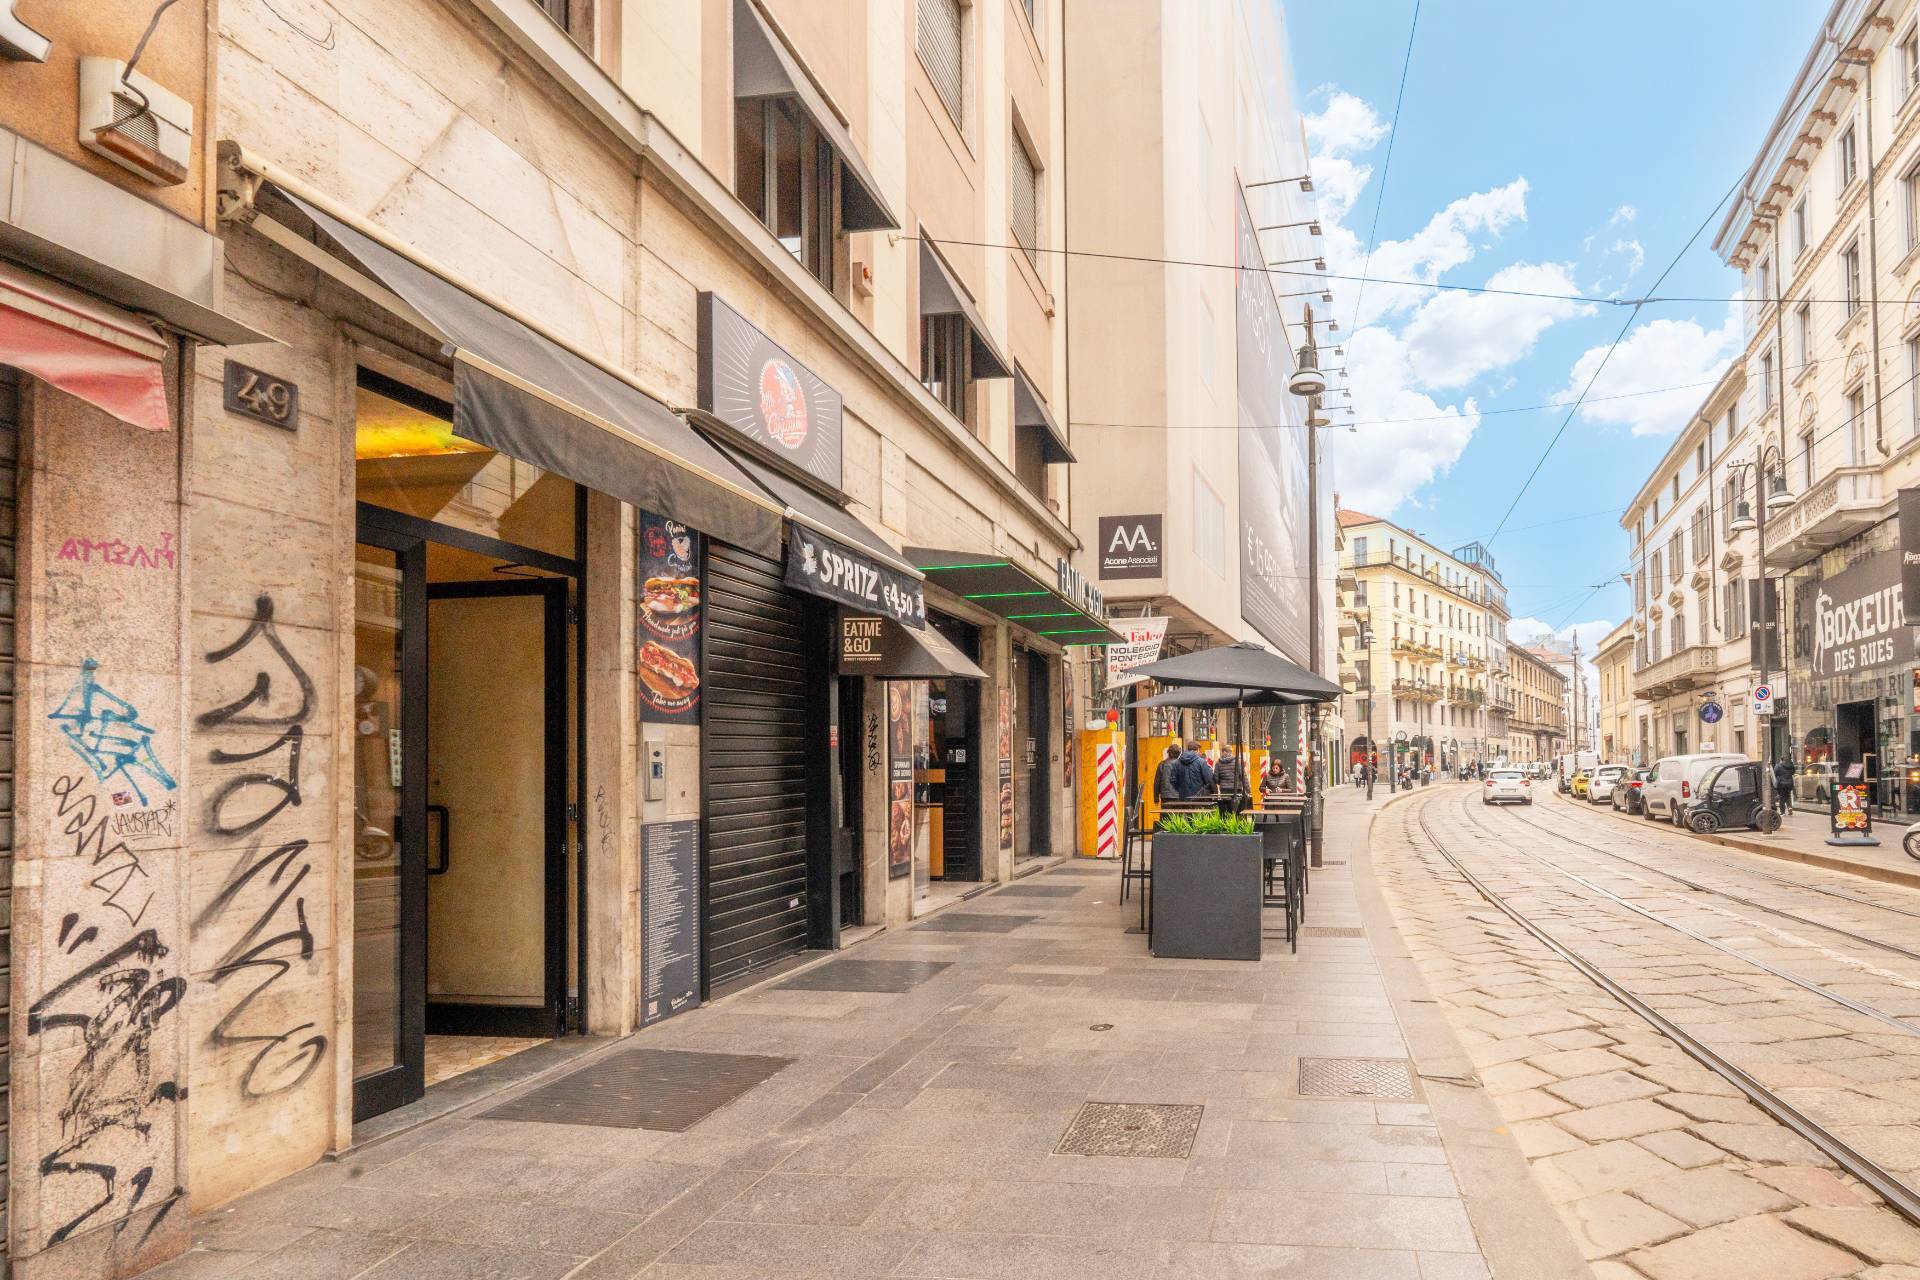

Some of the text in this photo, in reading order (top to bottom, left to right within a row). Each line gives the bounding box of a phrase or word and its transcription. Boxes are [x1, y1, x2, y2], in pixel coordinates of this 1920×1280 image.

[238, 372, 290, 421] 49
[1104, 557, 1127, 566] Acone
[1127, 555, 1158, 565] Associati
[819, 549, 878, 602] SPRITZ
[843, 621, 882, 637] EATME
[843, 637, 871, 652] &GO
[1110, 643, 1160, 654] NOLEGGIO
[1110, 650, 1158, 663] PONTEGGI
[1834, 637, 1894, 672] DES RUES
